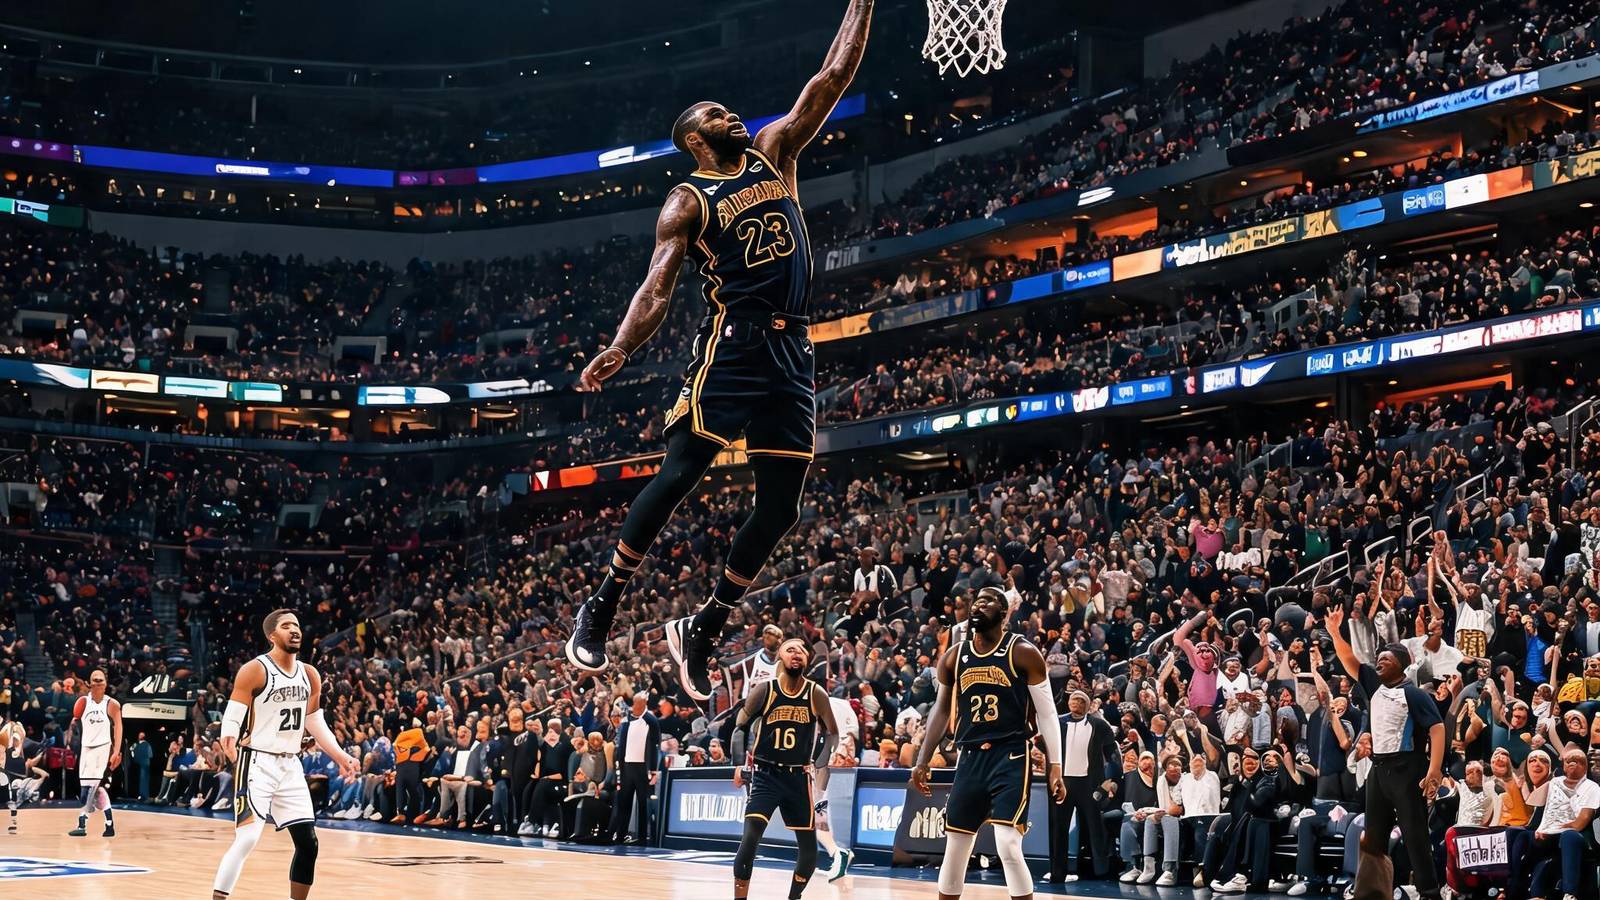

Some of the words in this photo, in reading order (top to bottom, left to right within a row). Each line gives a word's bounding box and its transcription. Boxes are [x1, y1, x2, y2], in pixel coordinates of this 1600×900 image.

[735, 212, 796, 269] 23
[970, 694, 999, 723] 23
[774, 727, 796, 749] 16
